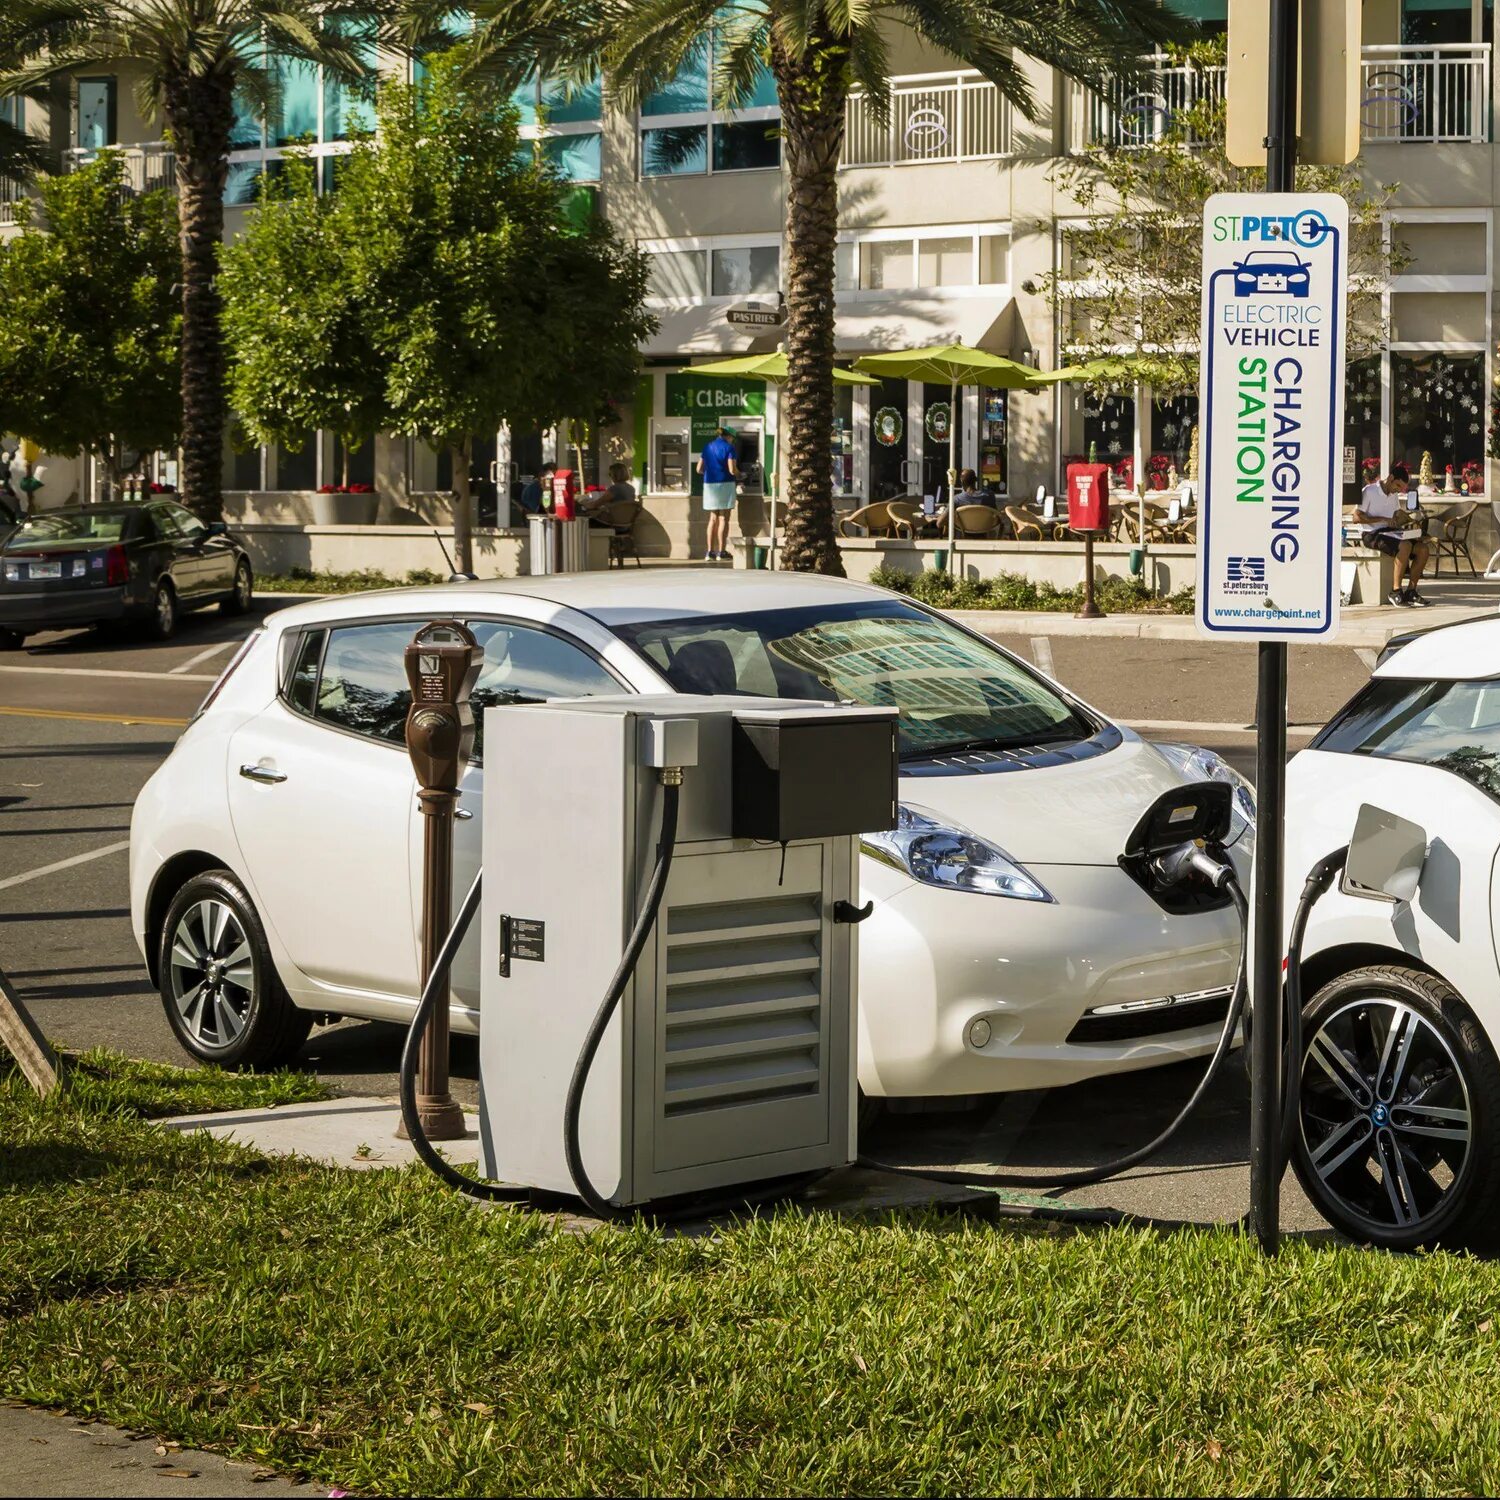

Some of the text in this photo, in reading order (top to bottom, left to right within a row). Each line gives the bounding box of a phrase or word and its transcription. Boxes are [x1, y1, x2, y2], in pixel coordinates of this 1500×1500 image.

[732, 311, 776, 324] PASTRIES
[1223, 304, 1322, 324] ELECTRIC
[1223, 327, 1320, 347] VEHICLE
[696, 387, 749, 407] C1 Bank
[1236, 356, 1268, 503] STATION
[1270, 356, 1303, 563] CHARGING
[1222, 582, 1269, 590] st.petersburg
[1214, 608, 1321, 620] www.chargepoint.net
